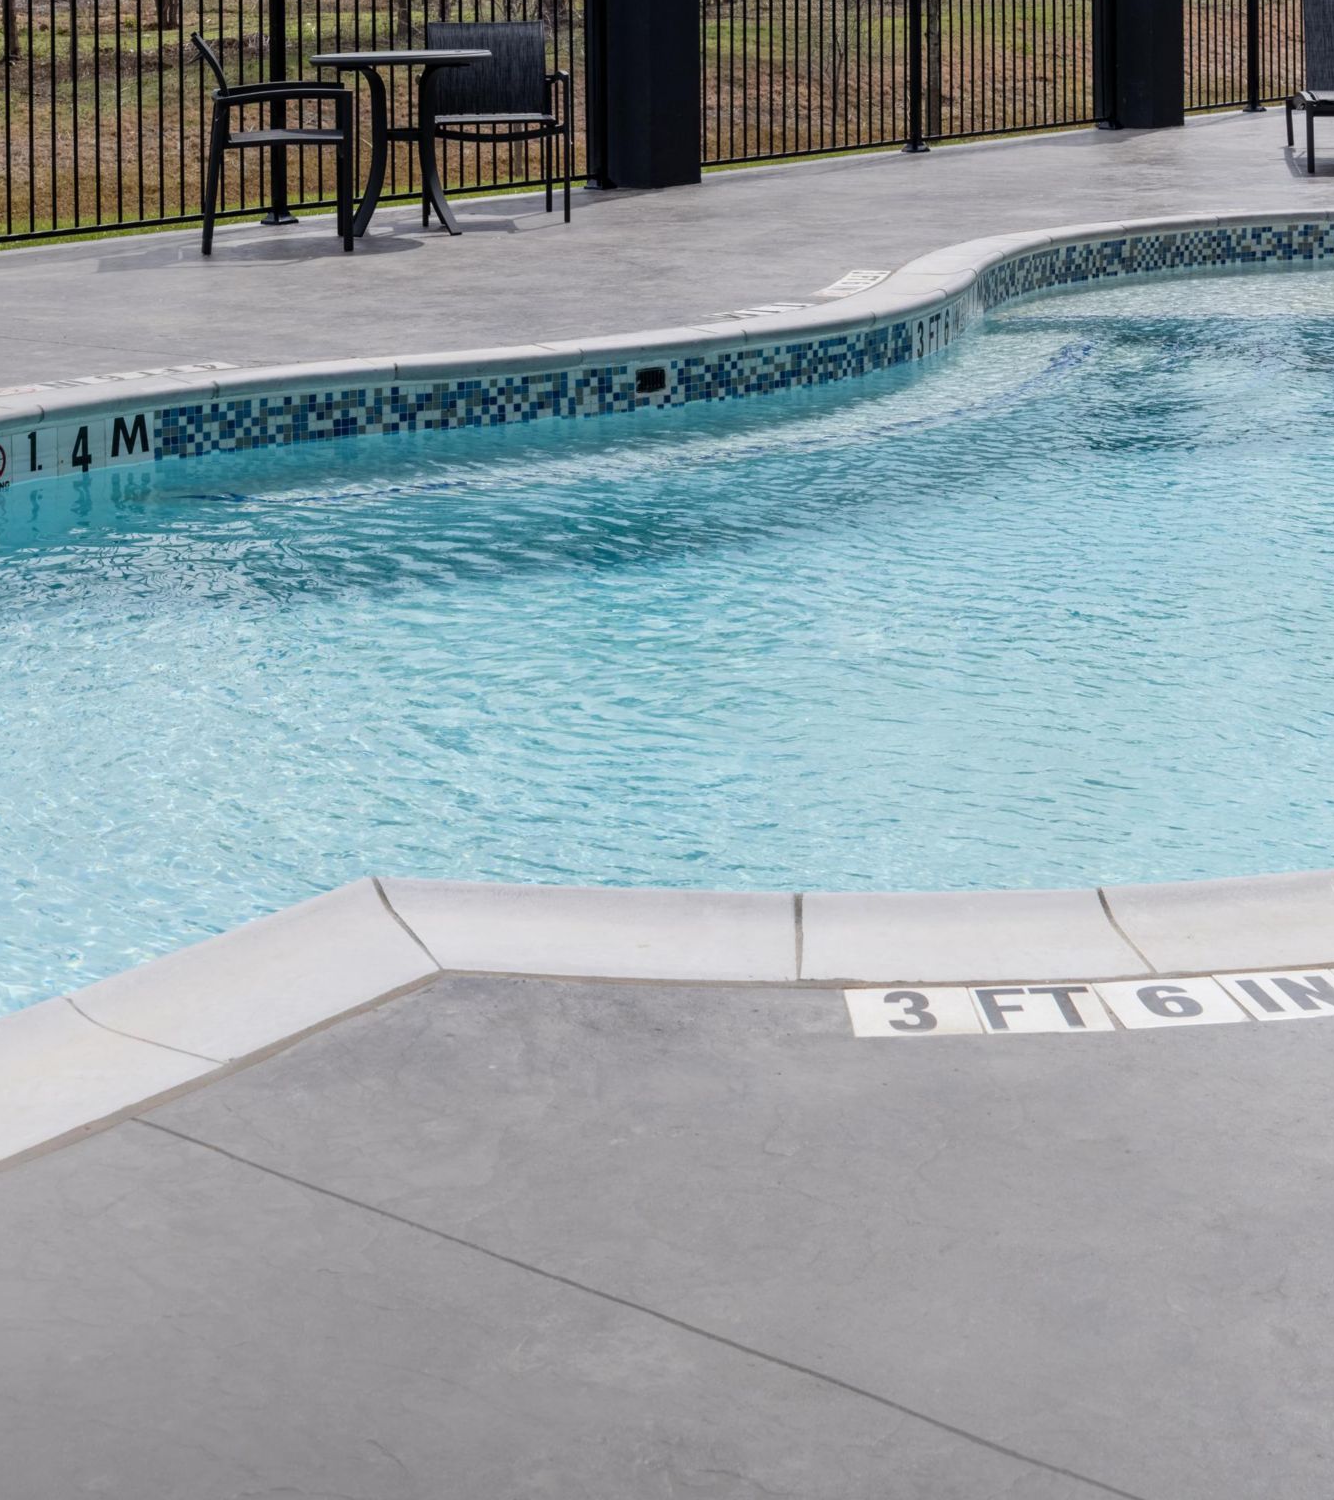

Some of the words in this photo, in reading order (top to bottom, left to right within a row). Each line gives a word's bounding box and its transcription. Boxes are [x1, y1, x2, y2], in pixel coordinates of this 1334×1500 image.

[917, 320, 924, 357] 3
[929, 312, 941, 353] FT
[111, 414, 149, 457] M
[883, 990, 938, 1033] 3
[975, 986, 1089, 1030] FT
[1134, 985, 1205, 1019] 6
